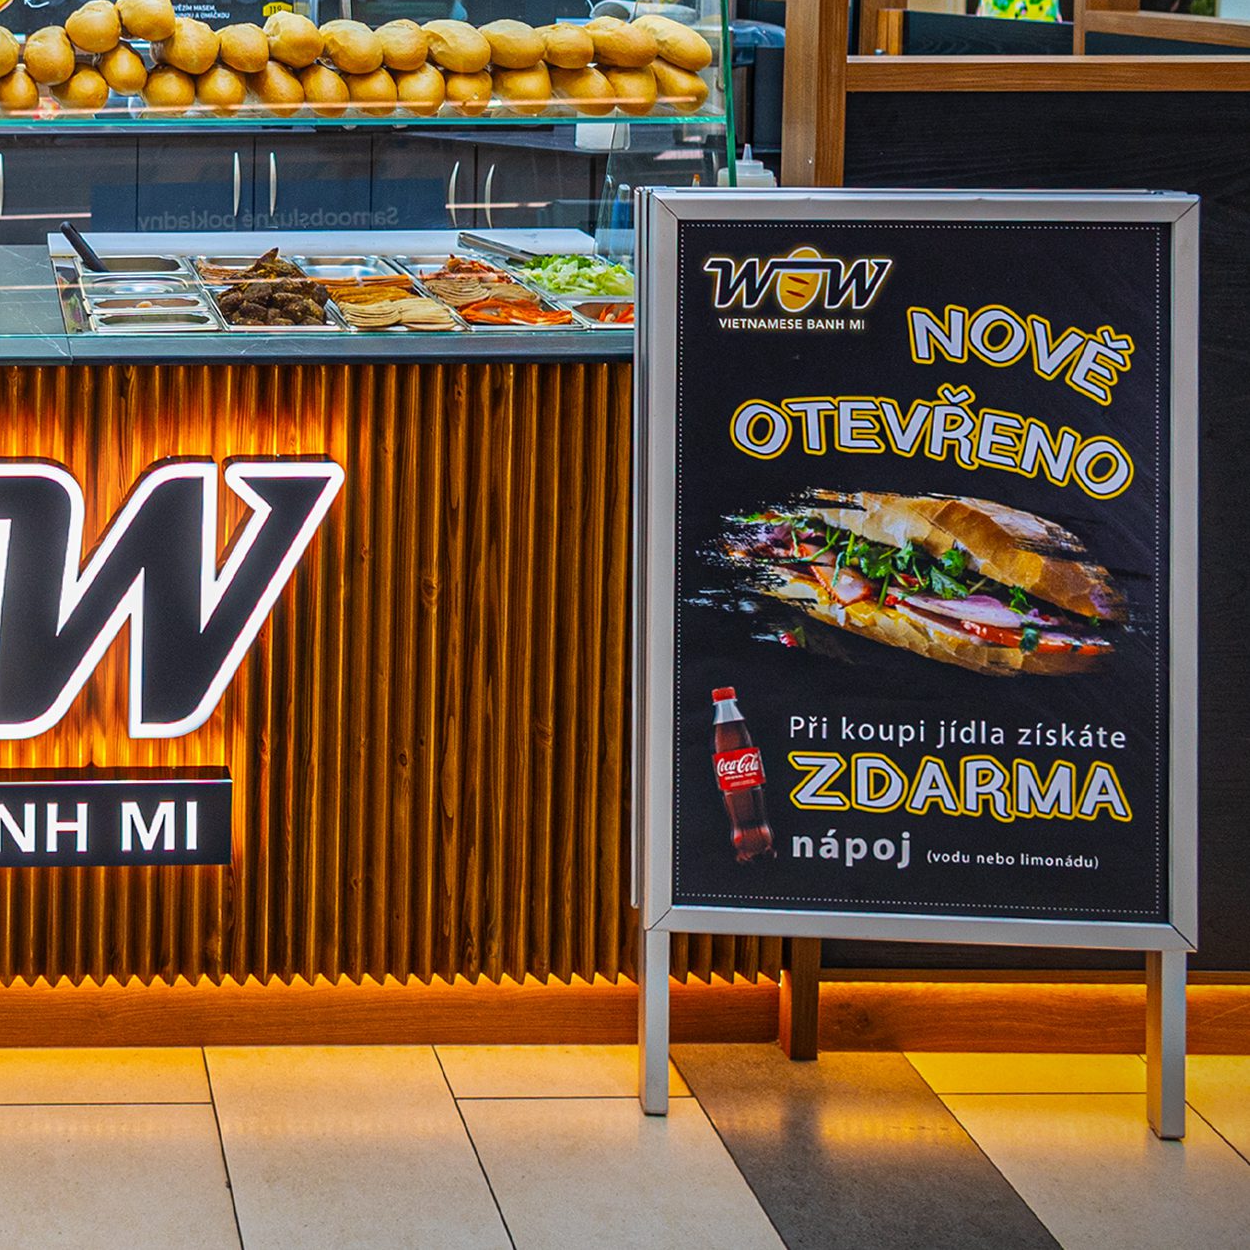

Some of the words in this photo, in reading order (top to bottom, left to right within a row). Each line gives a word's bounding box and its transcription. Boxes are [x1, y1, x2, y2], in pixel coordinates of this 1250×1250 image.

[703, 246, 893, 313] WOW
[718, 317, 803, 330] VIETNAMESE
[807, 317, 845, 330] BANH
[849, 317, 865, 330] MI
[907, 304, 1135, 406] NOVĚ
[729, 382, 1135, 500] OTEVŘENO
[790, 716, 828, 740] Při
[841, 717, 925, 748] koupi
[936, 720, 1005, 748] jídla
[1017, 723, 1127, 749] získáte
[788, 751, 1133, 823] ZDARMA
[120, 799, 200, 851] MI
[792, 829, 912, 869] nápoj
[927, 850, 972, 865] (vodu
[976, 852, 1015, 866] nebo
[1020, 852, 1100, 870] limonádu)
